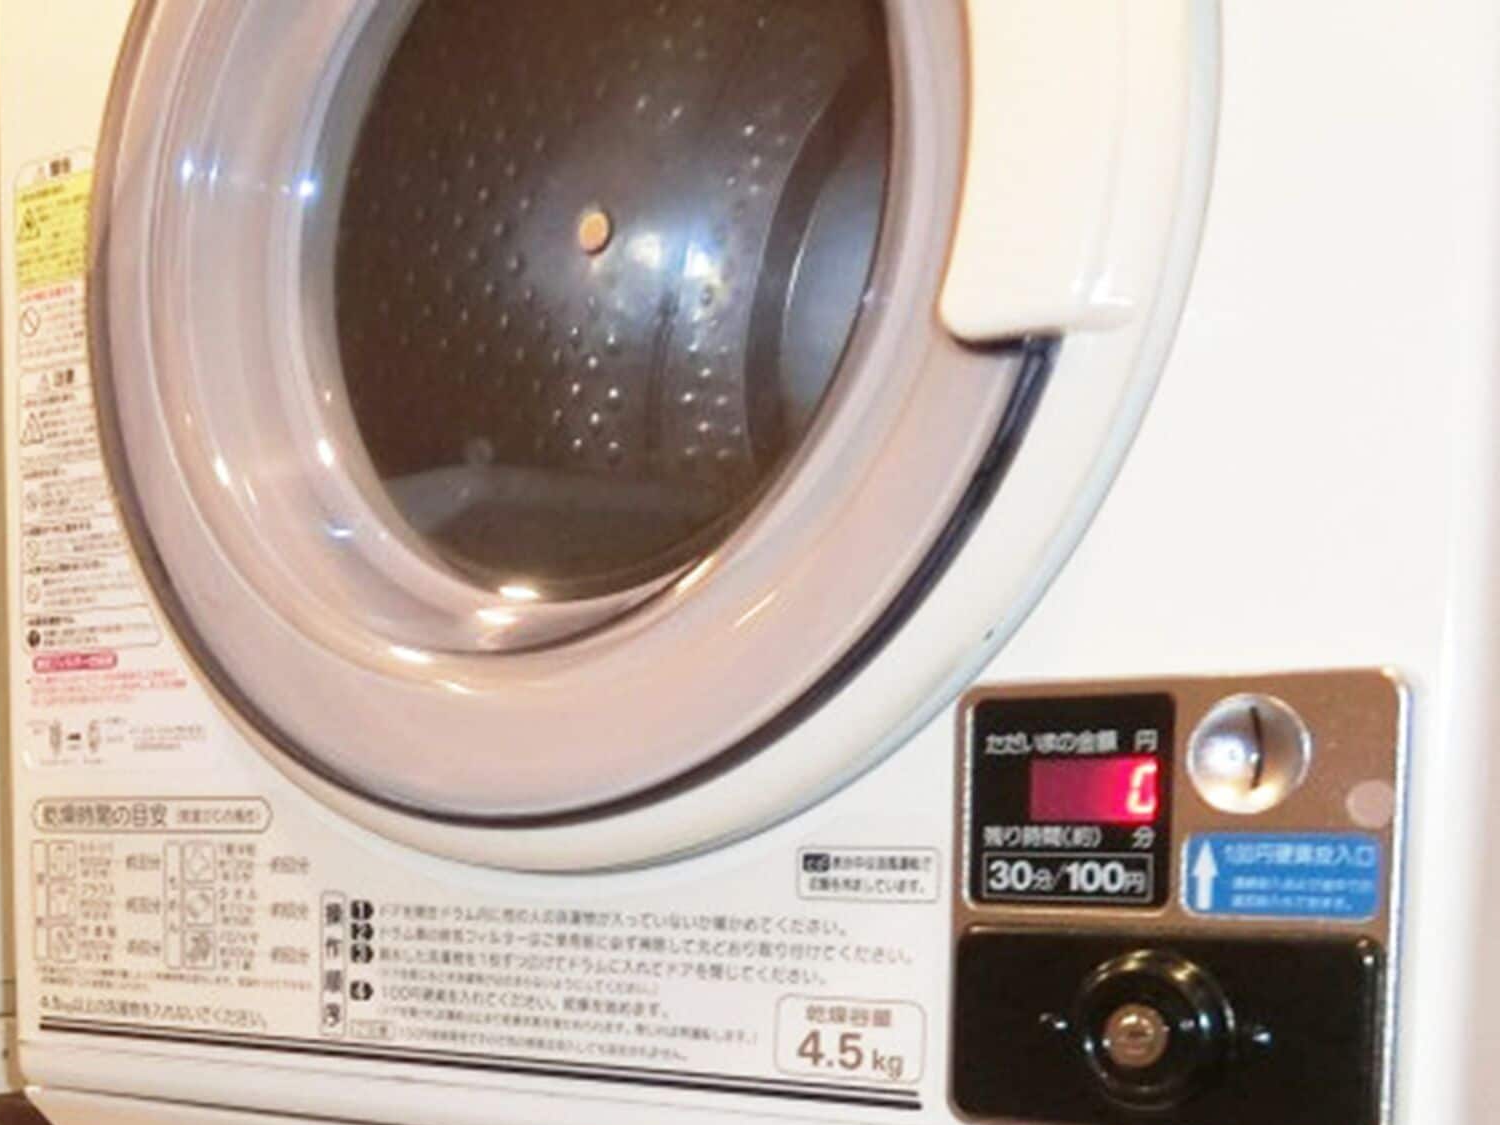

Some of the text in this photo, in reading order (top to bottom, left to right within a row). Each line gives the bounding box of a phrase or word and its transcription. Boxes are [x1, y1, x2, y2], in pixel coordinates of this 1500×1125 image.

[985, 729, 1158, 754] ただいまの金額 円
[983, 825, 1156, 849] 残り時間(約) 分
[989, 860, 1146, 894] 30分/100円
[796, 1030, 904, 1080] 4.5 kg
